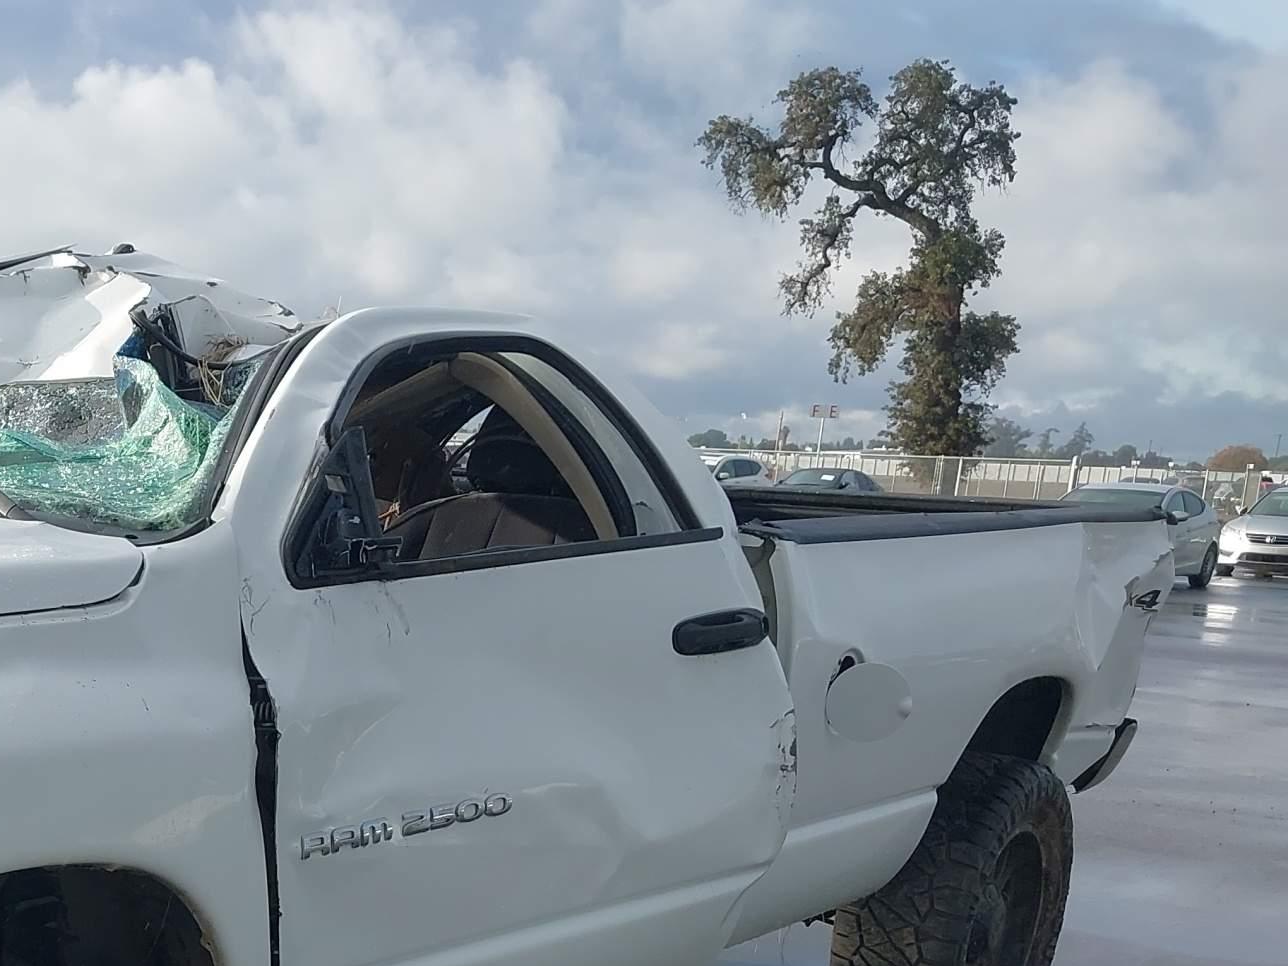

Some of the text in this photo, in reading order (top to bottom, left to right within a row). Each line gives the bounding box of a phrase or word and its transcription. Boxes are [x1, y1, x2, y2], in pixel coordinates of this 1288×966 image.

[812, 404, 838, 418] F E
[300, 791, 513, 861] RAM 2500
